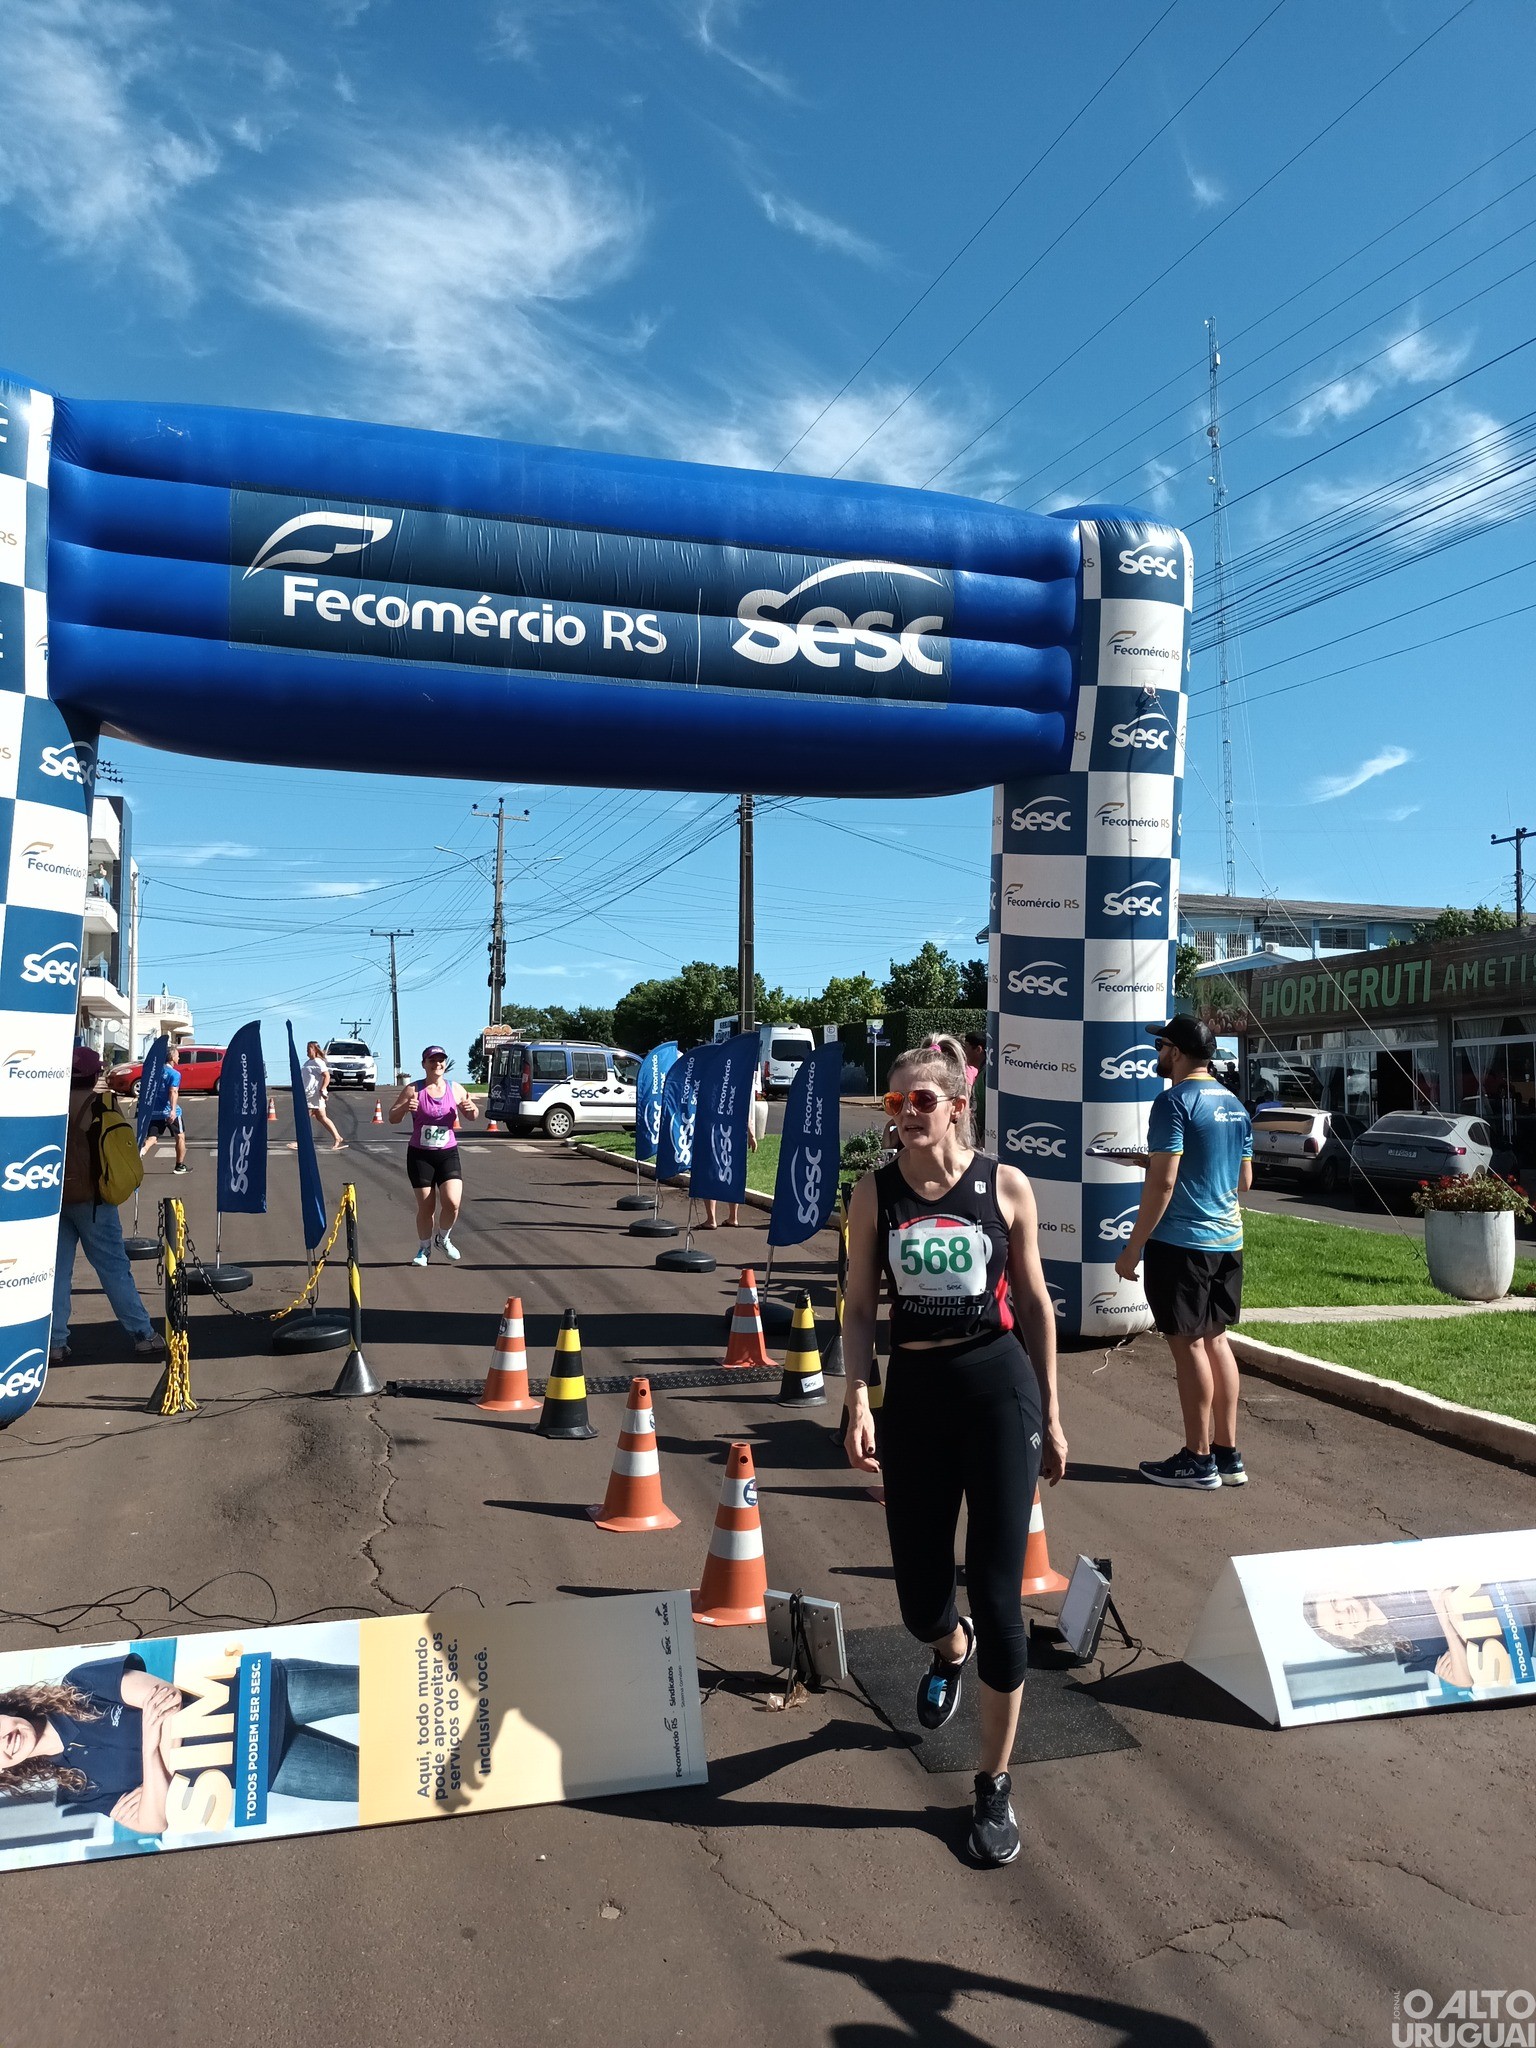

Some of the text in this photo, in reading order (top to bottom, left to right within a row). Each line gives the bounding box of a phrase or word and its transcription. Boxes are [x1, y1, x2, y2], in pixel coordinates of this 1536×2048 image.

[1118, 542, 1177, 579] Sesc
[284, 574, 668, 655] Fecomércio RS
[732, 560, 944, 675] Sesc
[1113, 644, 1170, 660] Fecomércio
[1170, 650, 1180, 661] RS
[1108, 713, 1169, 750] Sesc
[0, 747, 12, 759] S
[39, 741, 94, 787] Sesc
[1011, 796, 1071, 831] Sesc
[1101, 816, 1159, 828] Fecomércio
[1160, 818, 1170, 828] RS
[28, 858, 81, 877] Fecomércio
[1007, 896, 1060, 909] Fecomércio
[1063, 898, 1080, 909] RS
[1102, 880, 1161, 916] Sesc
[20, 942, 78, 986] Sesc
[1007, 961, 1068, 996] Sesc
[1098, 981, 1154, 993] Fecomércio
[1155, 982, 1164, 992] RS
[1261, 954, 1536, 1019] HORTIFRUTI AMETI
[9, 1067, 64, 1079] Fecomércio
[1004, 1055, 1058, 1072] Fecomércio
[1061, 1062, 1077, 1073] RS
[1100, 1045, 1158, 1079] Sesc
[240, 1053, 249, 1115] Fecomércio
[571, 1085, 600, 1099] Sesc
[718, 1058, 732, 1115] Fecomércio
[803, 1061, 816, 1134] Fecomércio
[424, 1128, 446, 1141] 642
[814, 1096, 824, 1136] Senac
[671, 1113, 695, 1165] Sesc
[711, 1124, 733, 1186] Sesc
[1005, 1122, 1066, 1158] Sesc
[2, 1145, 62, 1192] Sesc
[231, 1126, 254, 1195] Sesc
[792, 1145, 822, 1228] Sesc
[1060, 1223, 1076, 1234] RS
[900, 1236, 973, 1275] 568
[0, 1271, 48, 1289] ecomércio
[1096, 1303, 1149, 1315] Fecomércio
[1174, 1468, 1195, 1478] FILA
[1514, 1642, 1528, 1678] TODOS
[667, 1666, 677, 1707] Sindicatos
[111, 1705, 123, 1727] Sesc
[414, 1637, 433, 1798] Aqui, todo mundo
[430, 1632, 448, 1801] pode aproveitar os
[445, 1638, 463, 1790] serviços do Sesc.
[473, 1646, 491, 1775] Inclusive você.
[671, 1717, 678, 1729] RS
[246, 1658, 262, 1820] TODOS PODEM SER SESC.
[671, 1731, 683, 1778] Fecomércio
